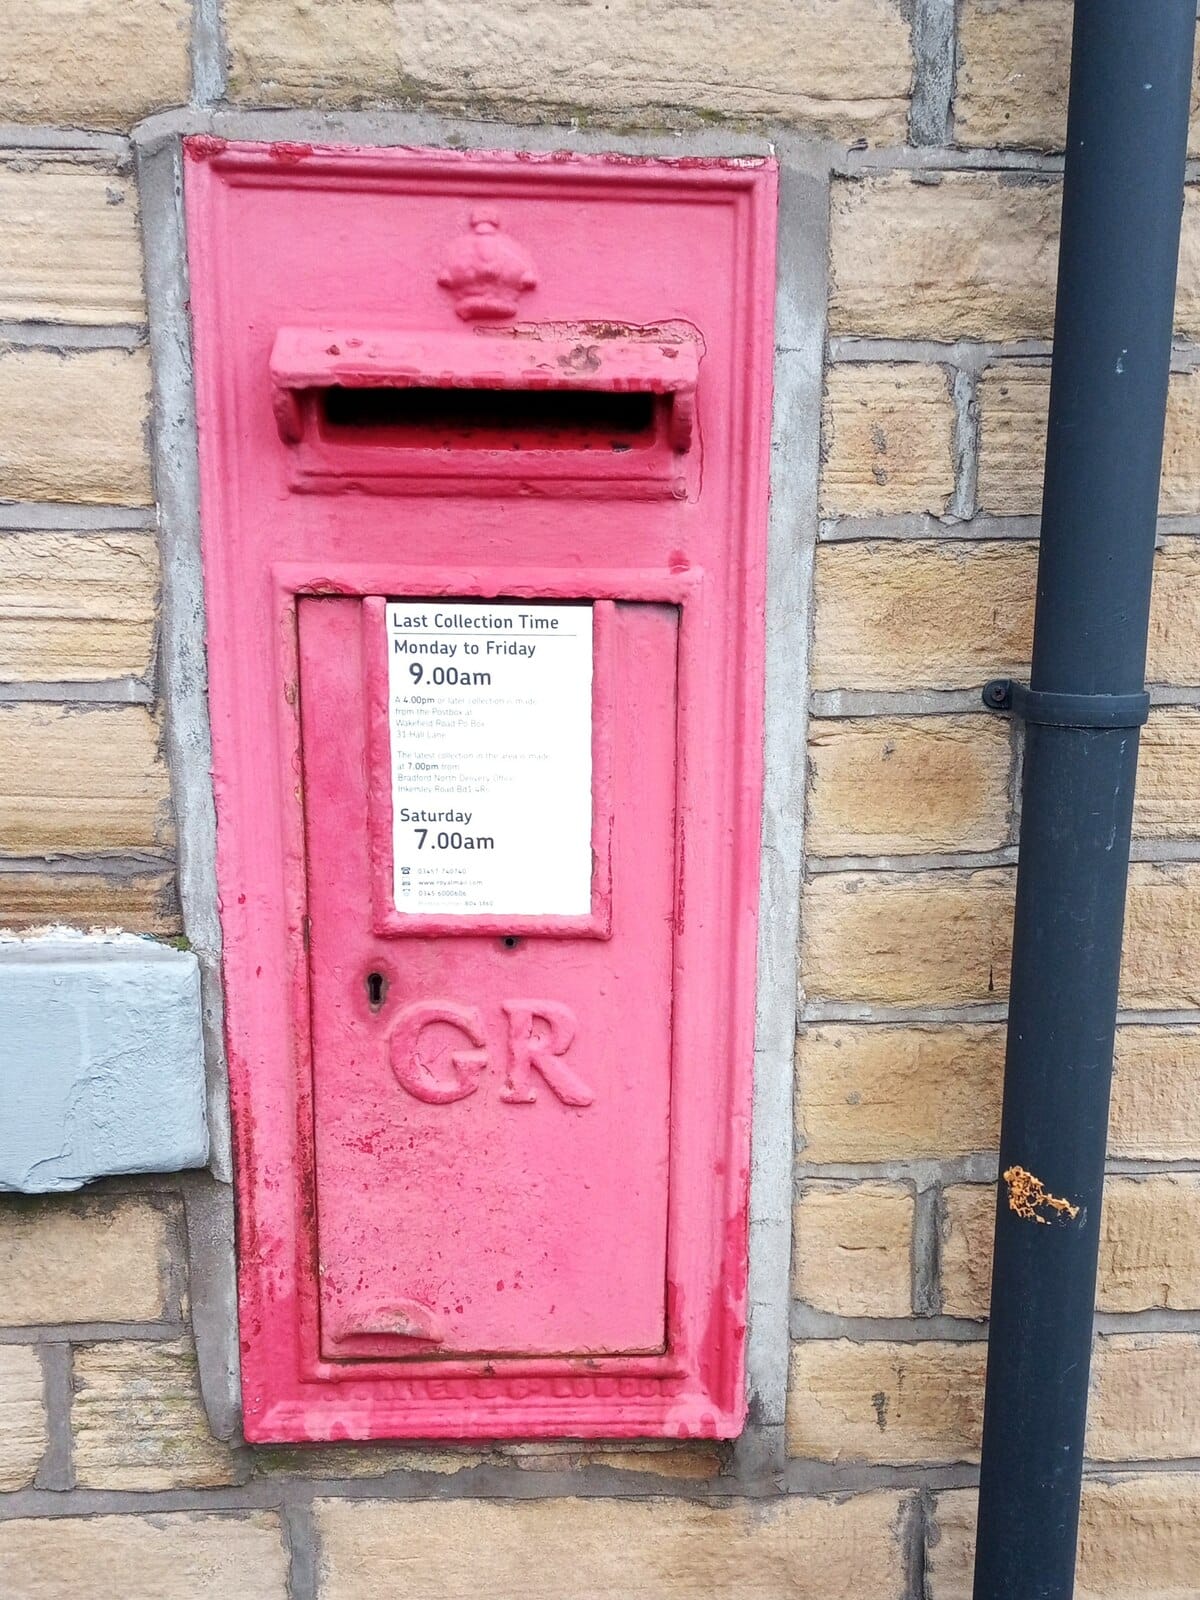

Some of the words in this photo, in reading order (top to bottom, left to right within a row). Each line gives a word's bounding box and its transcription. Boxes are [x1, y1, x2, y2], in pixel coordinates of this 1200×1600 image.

[393, 613, 428, 628] Last
[434, 613, 513, 629] Collection
[518, 614, 559, 629] Time
[394, 639, 457, 657] Monday
[464, 641, 480, 655] to
[486, 640, 536, 658] Friday
[409, 662, 492, 686] 9.00am
[402, 696, 435, 706] 4.00pm
[397, 751, 412, 759] The
[407, 762, 439, 772] 7.00pm
[397, 774, 432, 782] Bradford
[434, 774, 457, 782] North
[400, 808, 473, 825] Saturday
[414, 828, 495, 850] 7.00am
[388, 998, 594, 1107] GR
